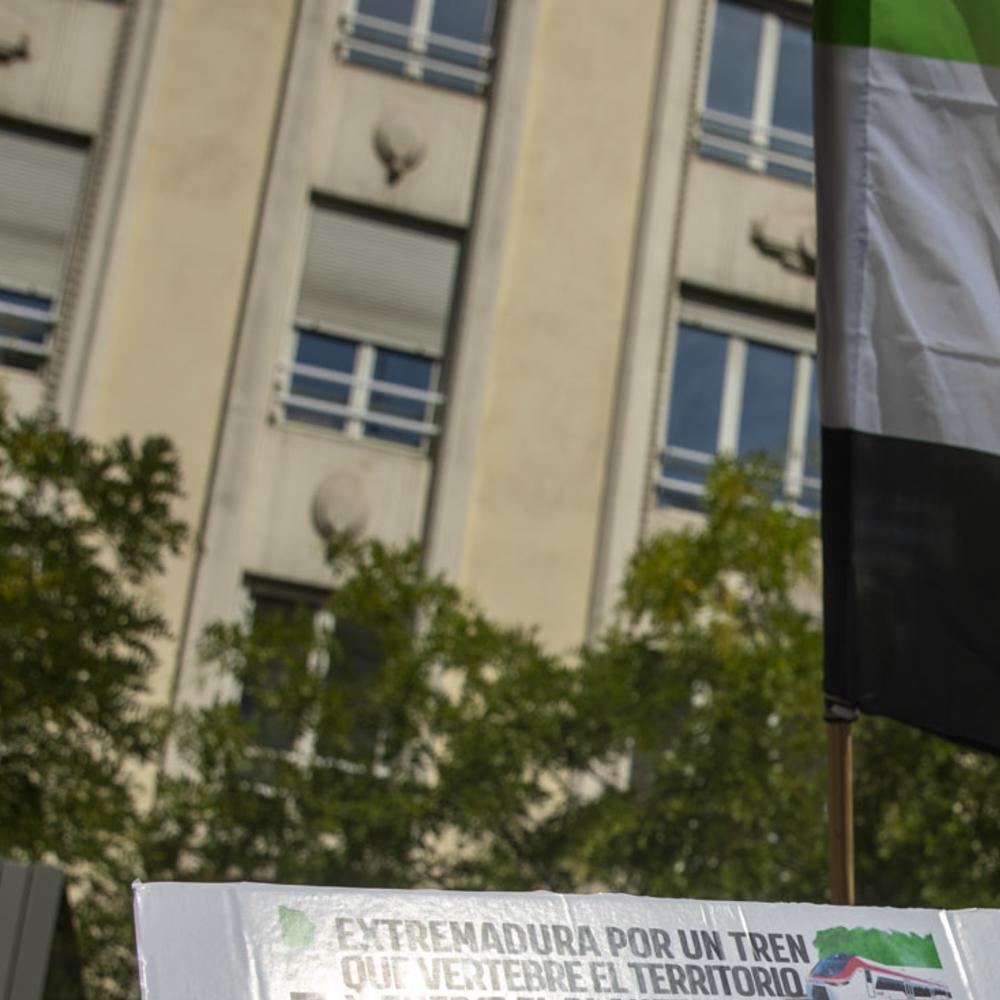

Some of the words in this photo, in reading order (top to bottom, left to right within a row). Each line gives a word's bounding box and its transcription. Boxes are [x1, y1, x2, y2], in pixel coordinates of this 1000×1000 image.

[335, 917, 601, 957] EXTREMADURA
[605, 926, 675, 960] POR
[677, 929, 725, 961] UN
[728, 931, 811, 964] TREN
[416, 957, 587, 993] VERTEBRE
[590, 961, 629, 994] EL
[628, 962, 807, 998] TERRITORIO
